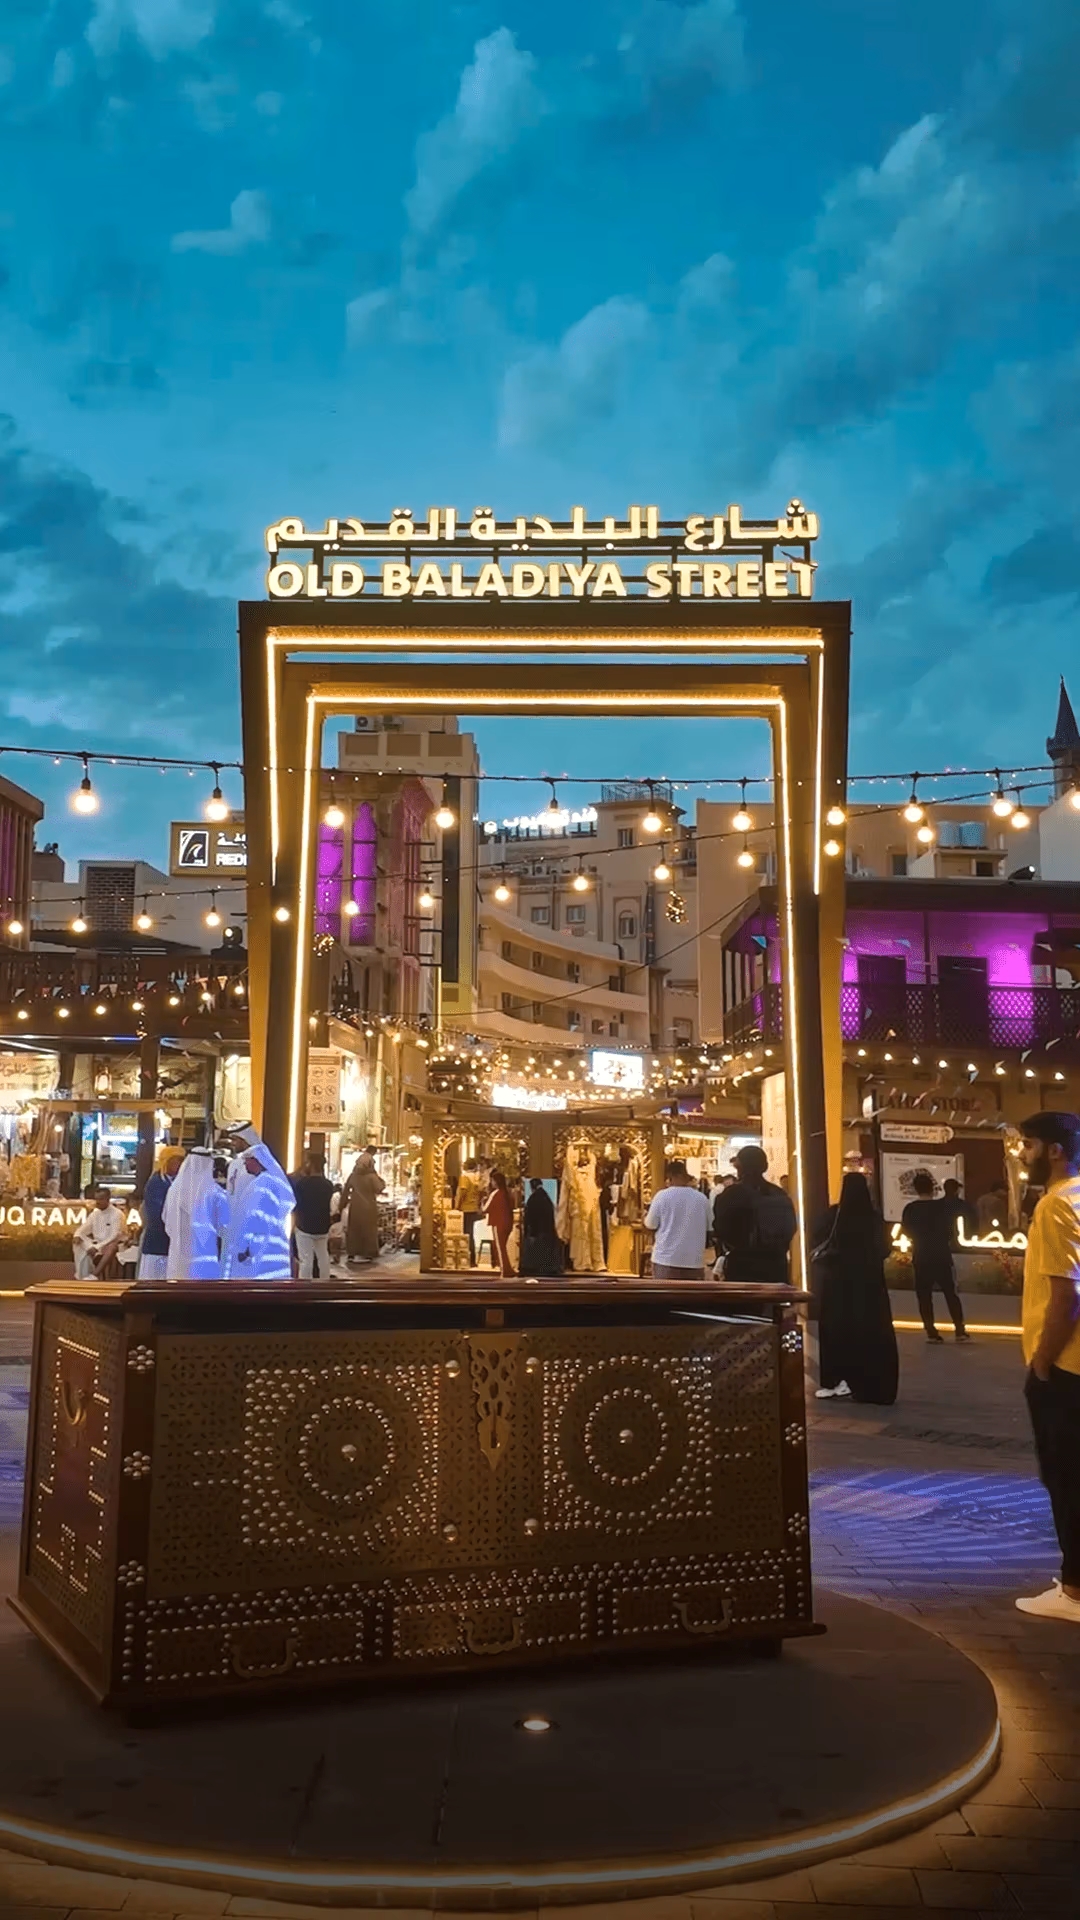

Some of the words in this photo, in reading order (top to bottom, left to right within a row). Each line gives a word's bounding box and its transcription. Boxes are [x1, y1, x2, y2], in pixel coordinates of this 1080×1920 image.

[266, 507, 458, 553] القديم
[469, 505, 658, 551] البلدية
[684, 499, 819, 551] شارع
[267, 562, 365, 597] OLD
[382, 562, 628, 598] BALADIYA
[645, 561, 815, 598] STREET
